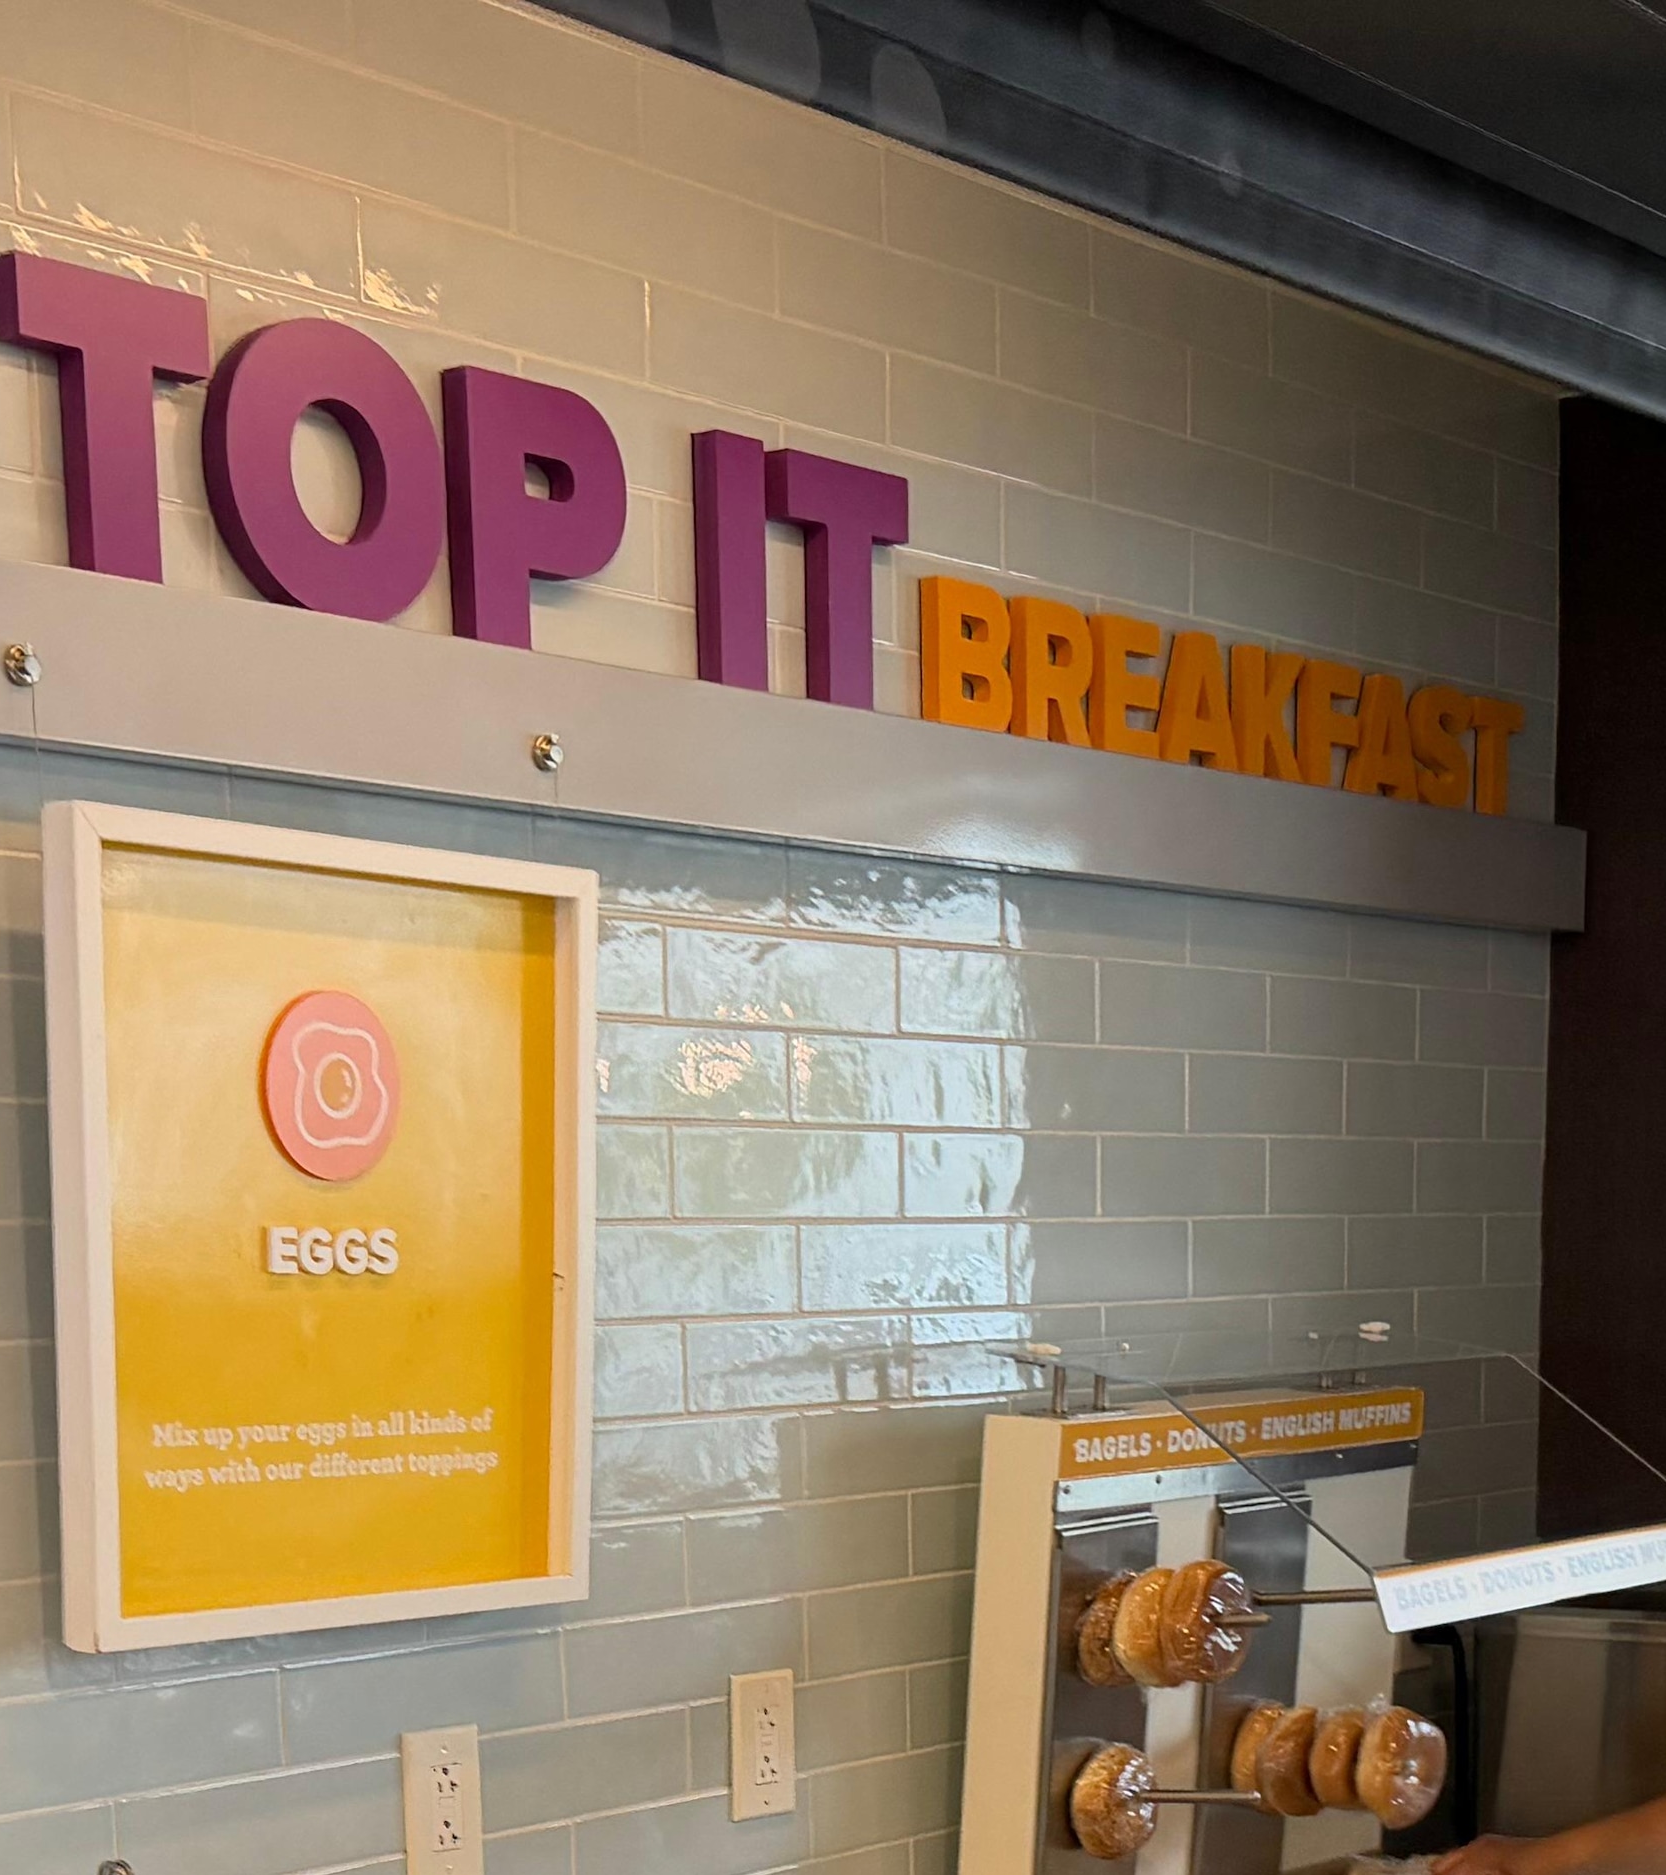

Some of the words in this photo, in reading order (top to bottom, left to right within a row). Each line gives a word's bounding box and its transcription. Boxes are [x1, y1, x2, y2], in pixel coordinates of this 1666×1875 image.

[690, 427, 910, 712] IT
[917, 573, 1526, 817] BREAKFAST
[261, 1225, 399, 1277] EGGS
[151, 1421, 199, 1448] Mix
[203, 1424, 233, 1451] up
[236, 1423, 291, 1450] your
[296, 1420, 347, 1446] eggs
[351, 1414, 375, 1438] in
[378, 1411, 406, 1437] all
[408, 1409, 468, 1435] kinds
[470, 1407, 494, 1432] of
[1073, 1432, 1152, 1464] BAGELS
[1167, 1419, 1247, 1453] DONUTS
[1260, 1410, 1335, 1441] ENGLISH
[1338, 1401, 1412, 1432] MUFFINS
[143, 1464, 205, 1493] ways
[207, 1456, 261, 1486] with
[264, 1459, 306, 1481] our
[309, 1450, 405, 1478] different
[408, 1446, 499, 1477] toppings
[1393, 1575, 1469, 1611] BAGELS
[1483, 1559, 1556, 1595] DONUTS
[1567, 1544, 1637, 1579] ENGLISH
